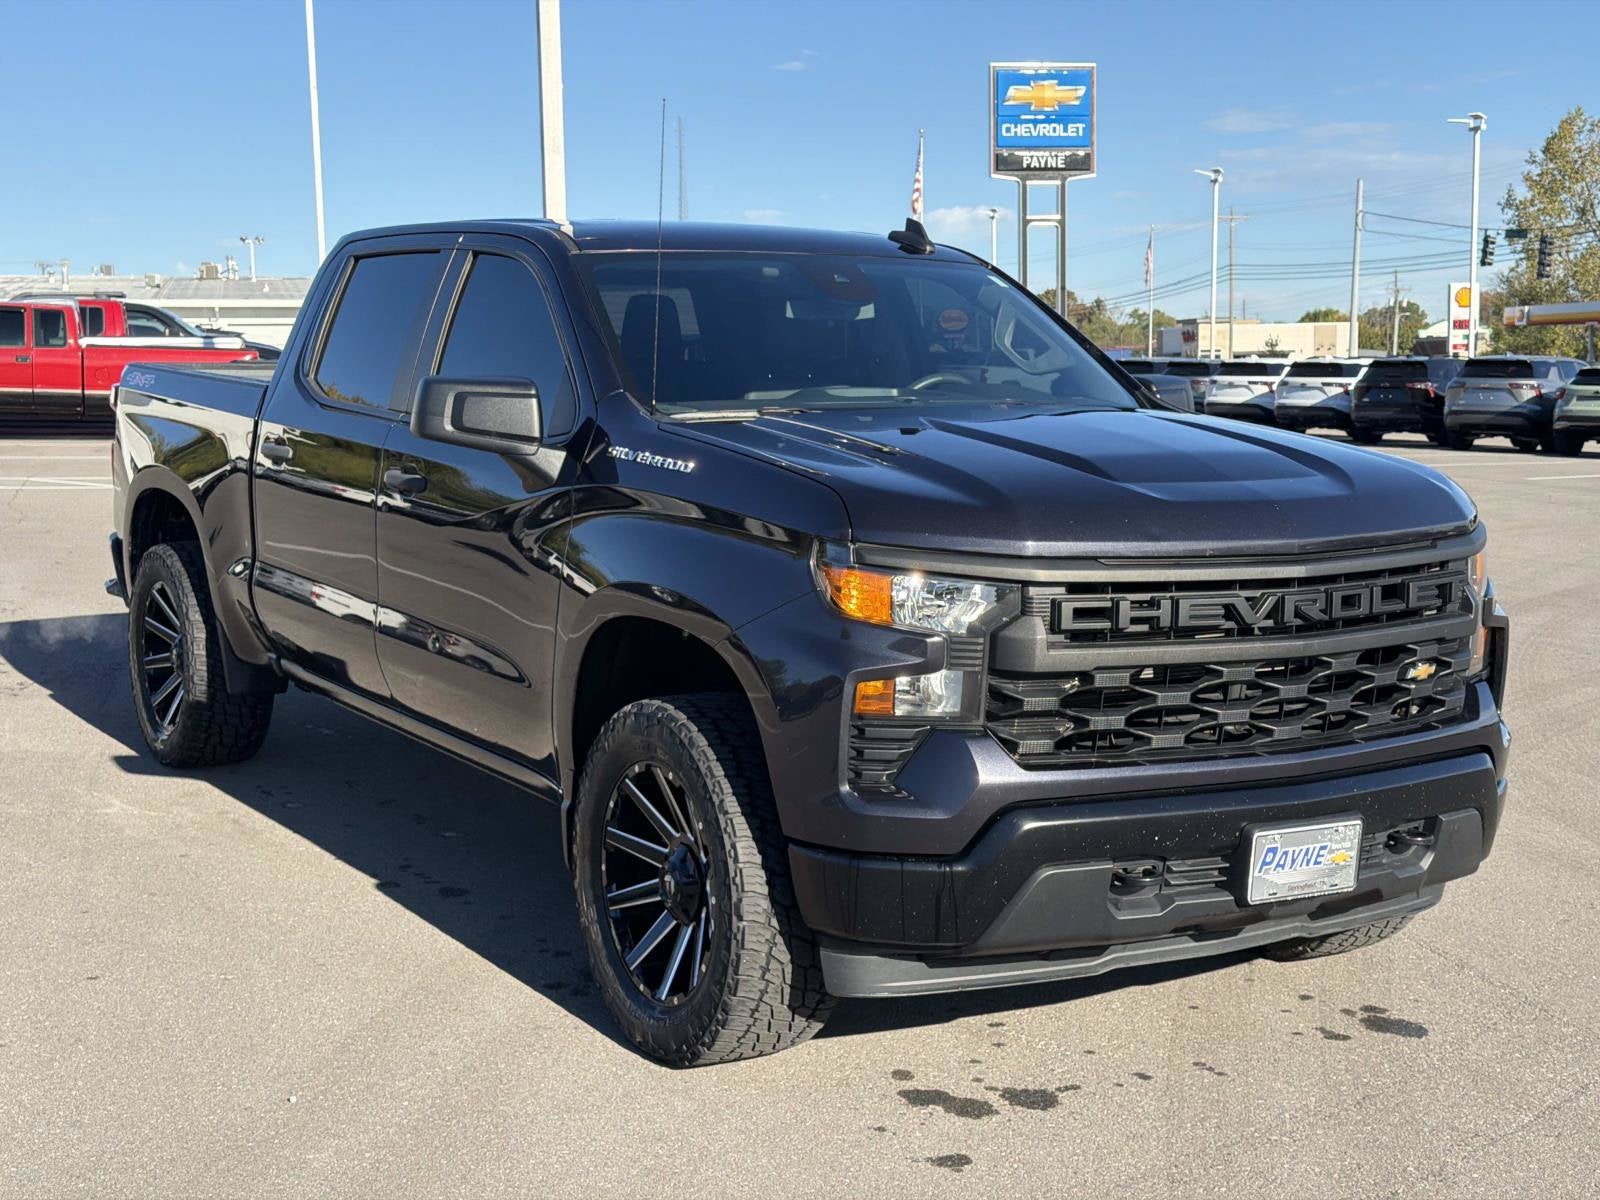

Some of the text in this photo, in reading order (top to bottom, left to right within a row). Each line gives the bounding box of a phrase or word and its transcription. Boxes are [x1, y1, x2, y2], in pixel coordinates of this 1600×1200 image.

[1001, 123, 1086, 137] CHEVROLET
[1022, 156, 1066, 169] PAYNE
[1051, 573, 1466, 633] CHEVROLET
